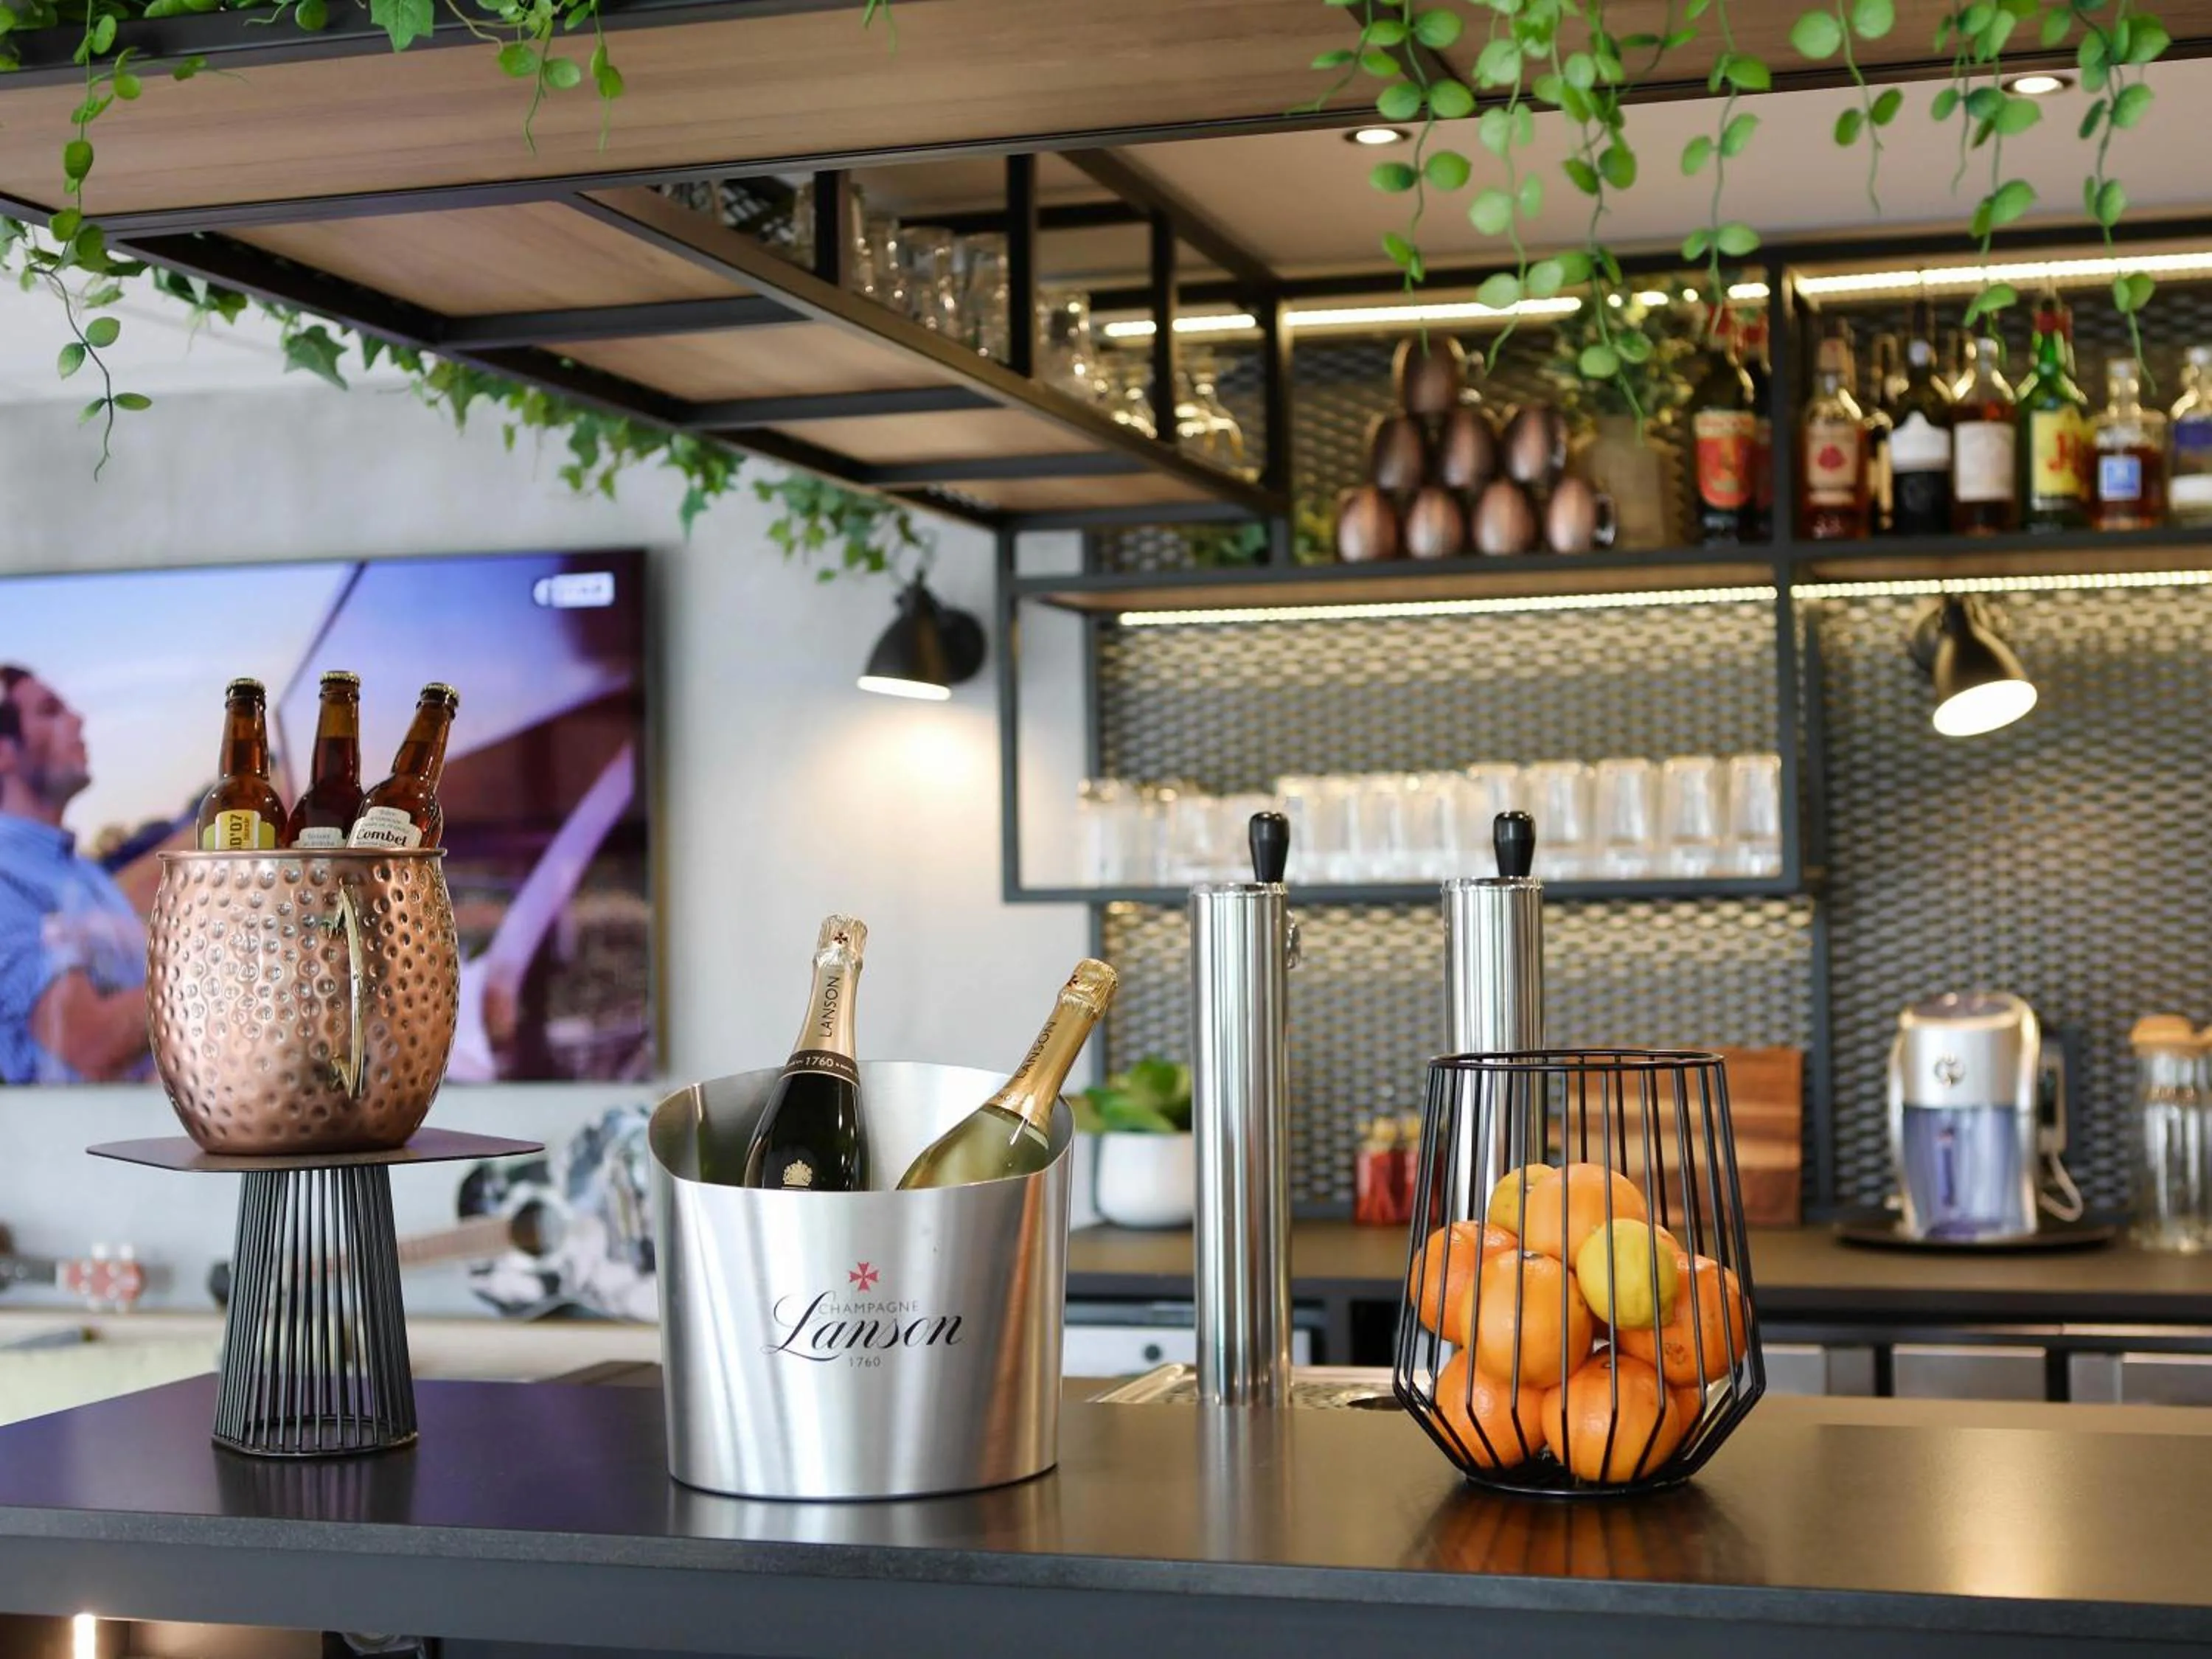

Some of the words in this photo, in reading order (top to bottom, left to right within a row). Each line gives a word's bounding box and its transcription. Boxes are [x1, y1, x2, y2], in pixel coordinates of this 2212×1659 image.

[819, 975, 840, 1037] LANSON
[805, 1057, 834, 1067] 1760
[1015, 1021, 1057, 1079] LANSON
[818, 1300, 920, 1315] CHAMPAGNE
[760, 1290, 965, 1362] Lanson
[849, 1357, 881, 1367] 1760
